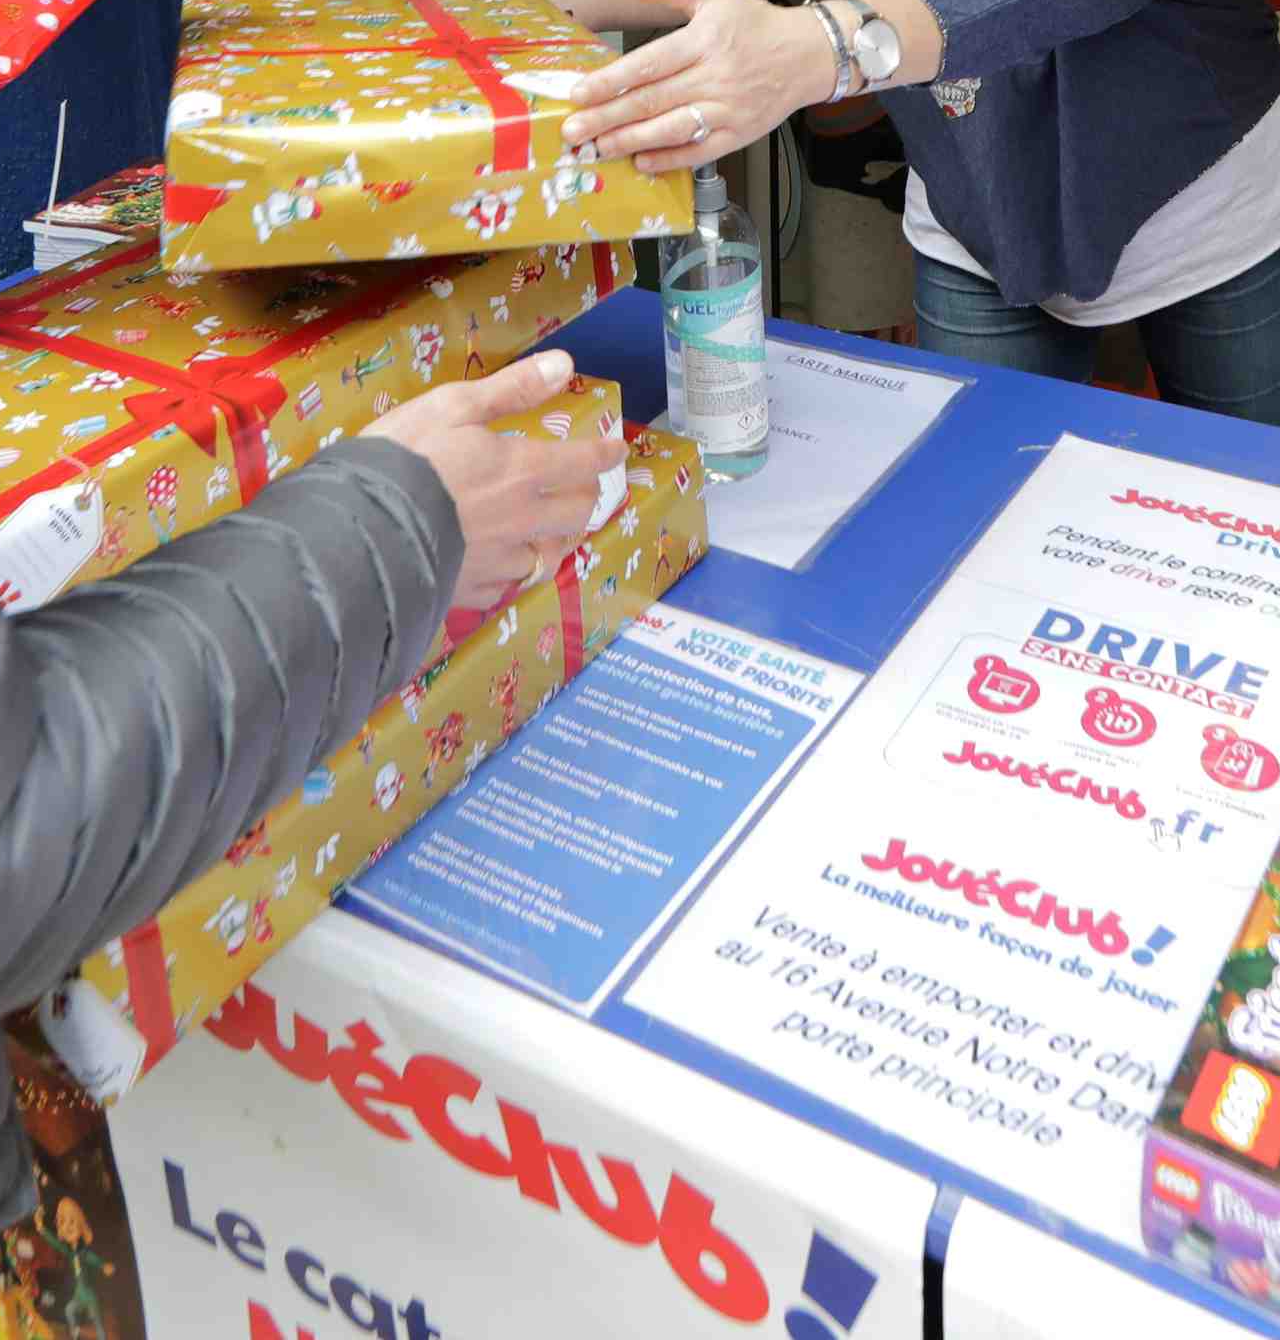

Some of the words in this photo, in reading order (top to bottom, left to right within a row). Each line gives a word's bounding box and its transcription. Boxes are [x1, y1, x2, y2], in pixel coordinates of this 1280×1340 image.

[786, 354, 832, 374] CARTE
[833, 367, 908, 392] MAGIQUE
[1041, 544, 1107, 568] votre
[1109, 559, 1176, 589] drive
[1181, 582, 1254, 609] reste
[1047, 524, 1158, 561] Pendant
[1160, 549, 1186, 570] le
[635, 659, 718, 698] protection
[710, 688, 738, 707] de
[730, 696, 778, 722] tous,
[674, 637, 739, 673] NOTRE
[741, 662, 835, 712] PRIORITÉ
[689, 627, 754, 661] VOTRE
[757, 650, 828, 686] SANTÉ
[1025, 639, 1105, 680] SANS
[1106, 660, 1254, 720] CONTACT
[1030, 608, 1269, 702] DRIVE
[820, 863, 850, 887] La
[853, 876, 970, 934] meilleure
[977, 919, 1054, 969] façon
[1058, 955, 1094, 980] de
[1099, 965, 1179, 1016] jouer
[714, 937, 759, 968] au
[767, 955, 814, 990] 16
[811, 978, 952, 1048] Avenue
[954, 1034, 1063, 1096] Notre
[754, 904, 848, 960] Vente
[849, 948, 878, 972] à
[880, 963, 1047, 1041] emporter
[1048, 1027, 1094, 1057] et
[1094, 1048, 1172, 1095] driv
[774, 1006, 876, 1063] porte
[878, 1050, 1064, 1148] principale
[162, 1158, 267, 1272] Le
